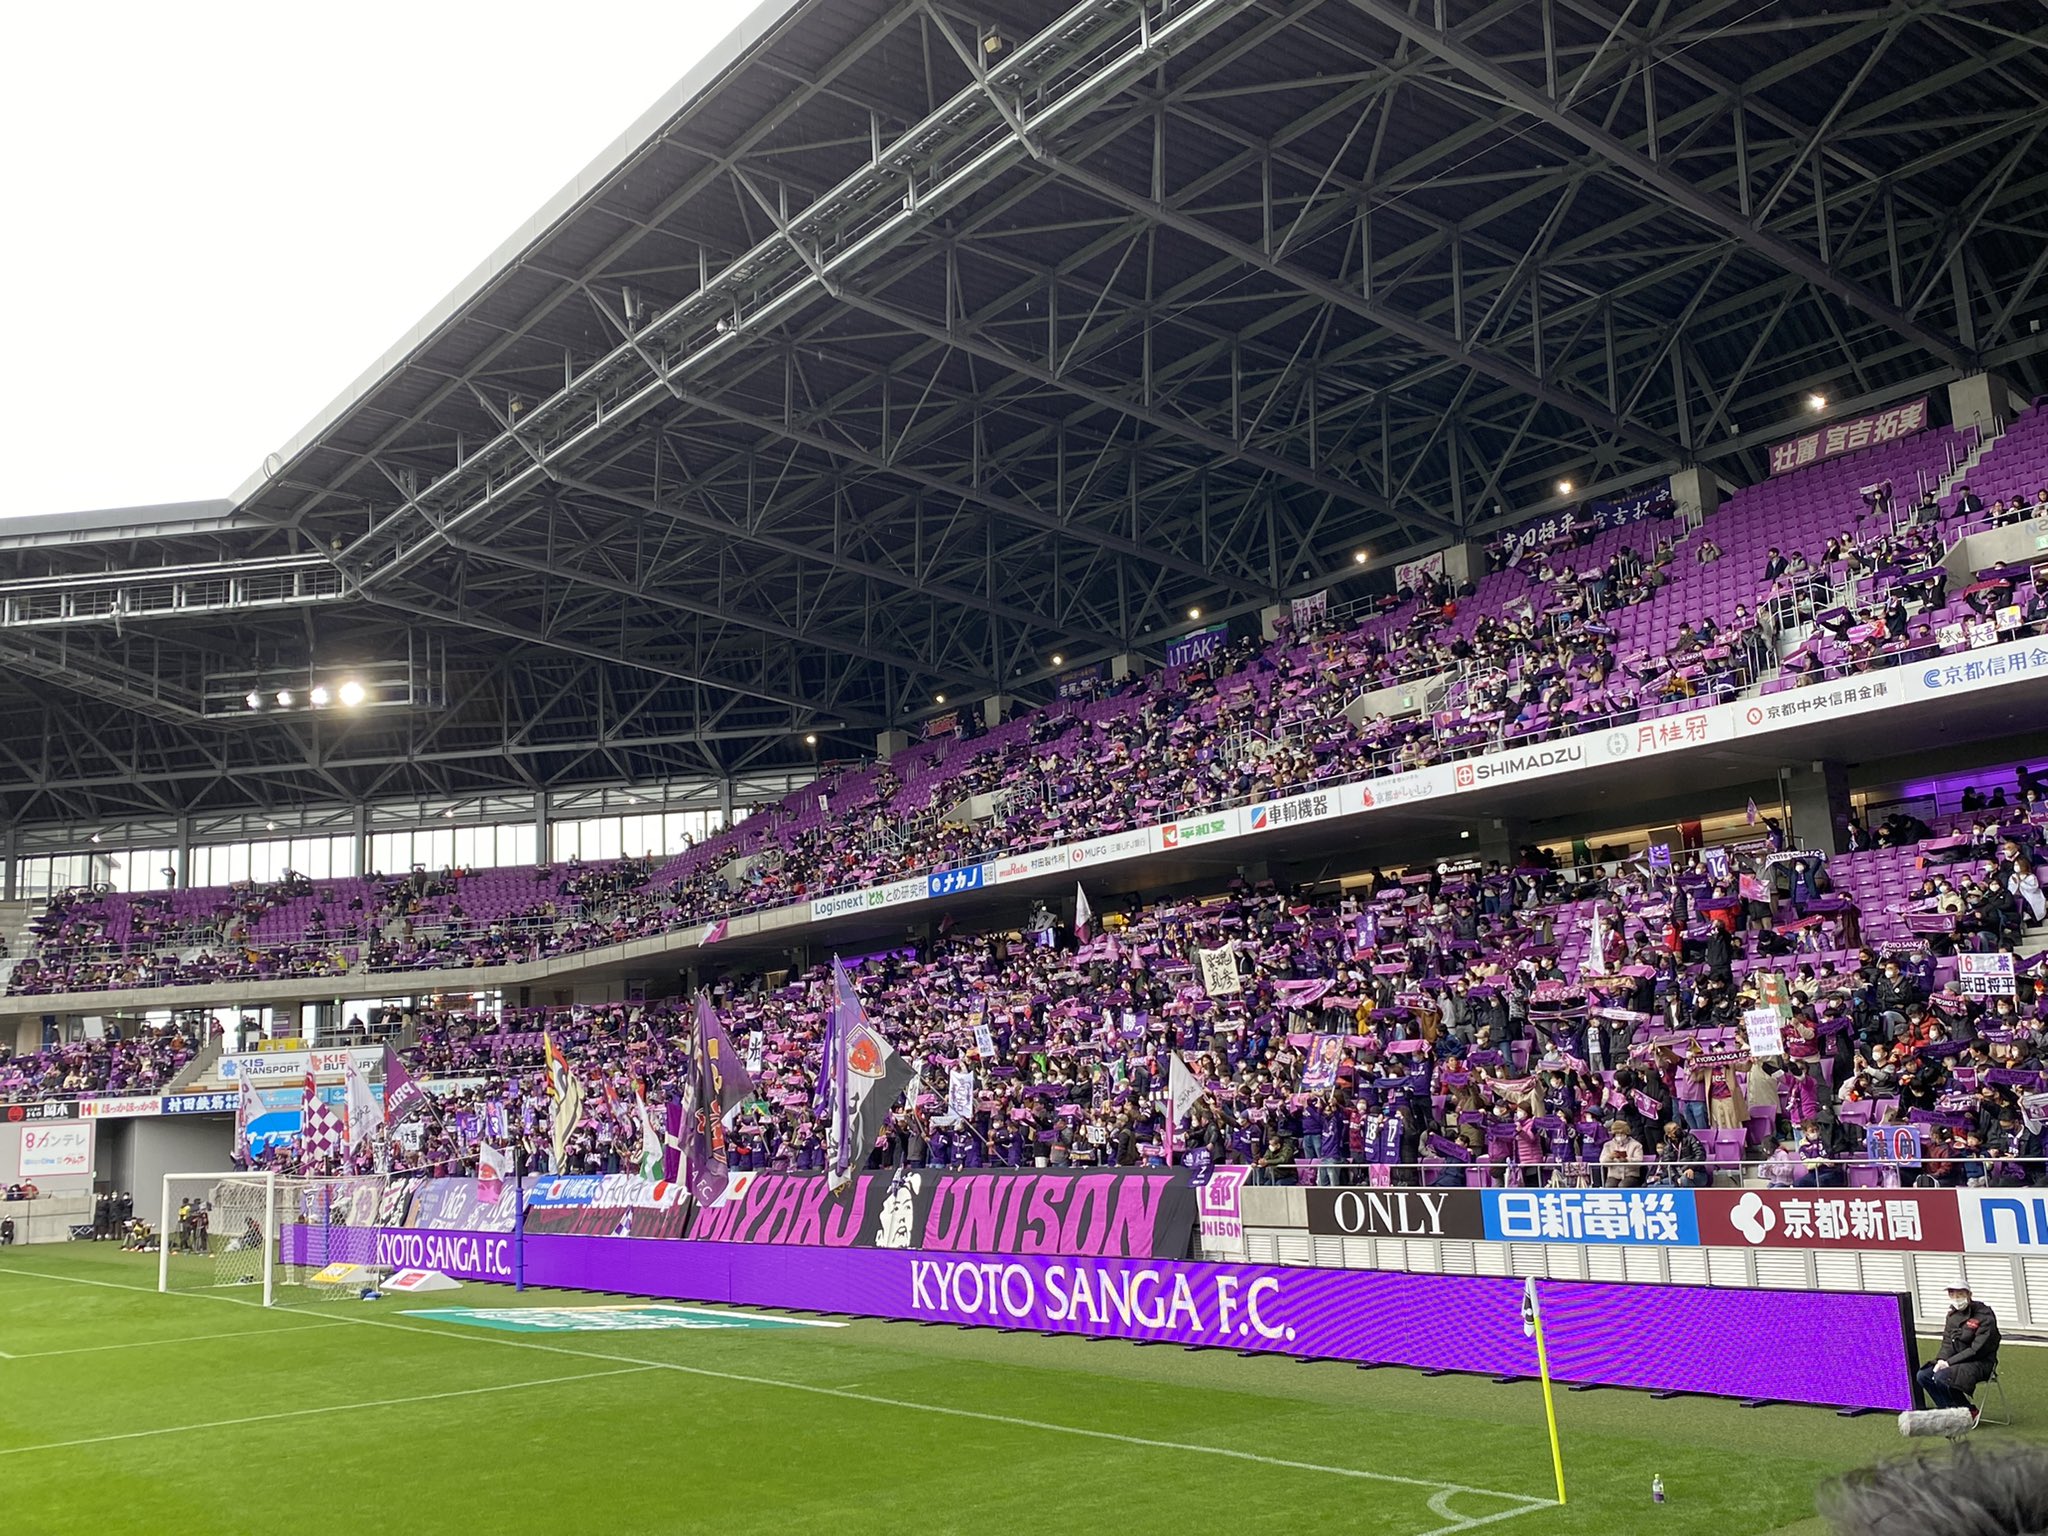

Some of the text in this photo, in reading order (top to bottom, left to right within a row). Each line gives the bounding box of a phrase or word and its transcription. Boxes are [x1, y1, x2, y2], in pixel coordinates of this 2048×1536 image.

[1772, 402, 1926, 472] 壮麗 宮吉拓実
[1765, 681, 1889, 720] 京都中央信用金庫
[1637, 714, 1709, 753] 月桂冠
[1476, 744, 1582, 780] SHIMADZU
[1180, 819, 1226, 839] 平和堂
[1031, 852, 1066, 870] 村田製作所
[1084, 845, 1107, 859] MUFG
[1709, 857, 1727, 878] 14
[943, 868, 978, 893] ナカノ
[886, 881, 928, 903] とめ研究所
[814, 893, 864, 916] Logisnext
[1958, 954, 1973, 972] 16
[1959, 976, 2015, 993] 武田将平
[324, 1053, 347, 1063] KIS
[1695, 1055, 1716, 1063] KYOTO
[1717, 1053, 1739, 1062] SANGA
[245, 1064, 300, 1075] RANSPORT
[101, 1101, 160, 1115] ほっかほっか亭
[1365, 1121, 1378, 1141] 18
[1387, 1125, 1398, 1143] 17
[922, 1173, 1175, 1258] UNISON
[1333, 1190, 1449, 1236] ONLY
[1497, 1192, 1680, 1241] 日新電機
[1778, 1197, 1923, 1242] 京都新聞
[1200, 1221, 1243, 1238] UNISON
[376, 1233, 512, 1276] KYOTO SANGA F.C.
[910, 1260, 1297, 1342] KYOTO SANGA F.C.
